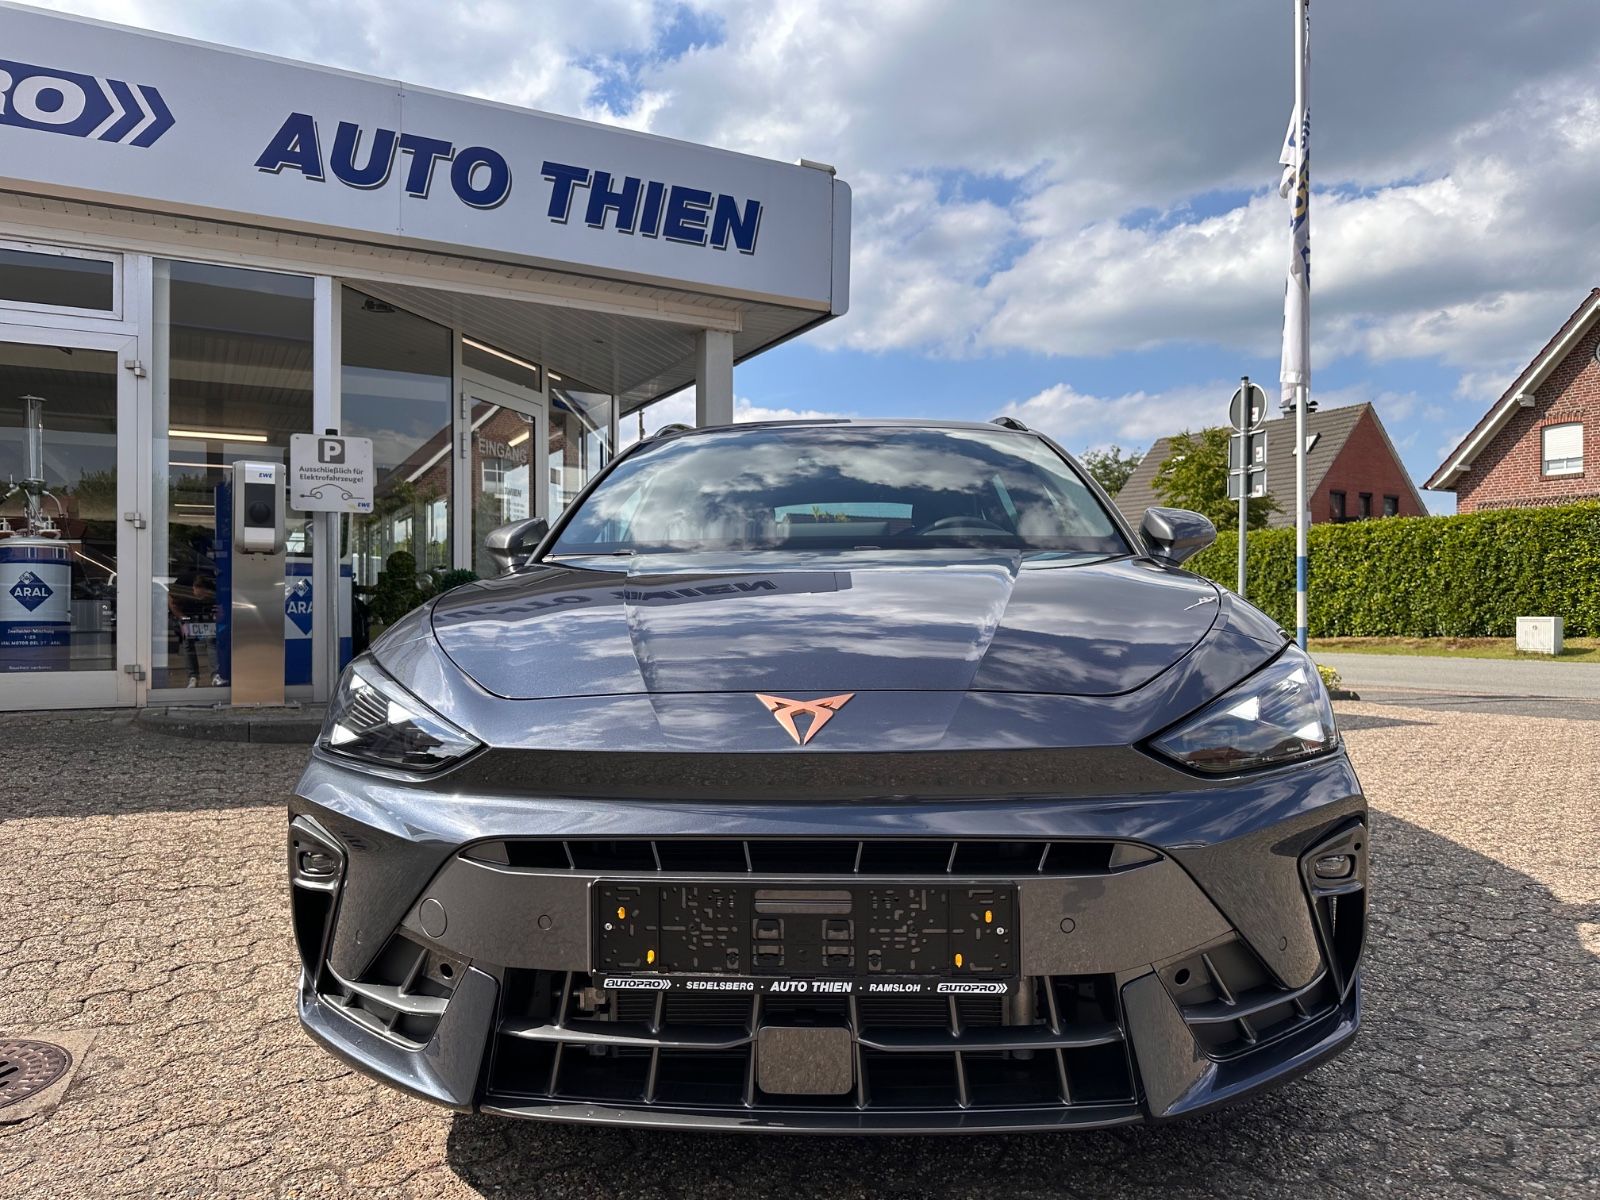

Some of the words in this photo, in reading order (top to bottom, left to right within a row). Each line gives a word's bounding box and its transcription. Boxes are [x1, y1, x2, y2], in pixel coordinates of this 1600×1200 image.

[0, 68, 86, 125] O
[254, 112, 512, 210] AUTO
[541, 161, 763, 255] THIEN
[324, 441, 342, 462] P
[478, 437, 528, 464] EINGANG
[299, 466, 352, 475] Ausschließlich
[353, 468, 364, 476] für
[299, 473, 364, 484] Elektrofahrzeuge!
[14, 587, 49, 597] ARAL
[287, 601, 313, 614] ARA
[686, 981, 754, 990] SEDELSBERG
[770, 981, 808, 992] AUTO
[811, 981, 853, 993] THIEN
[869, 983, 921, 992] RAMSLOH
